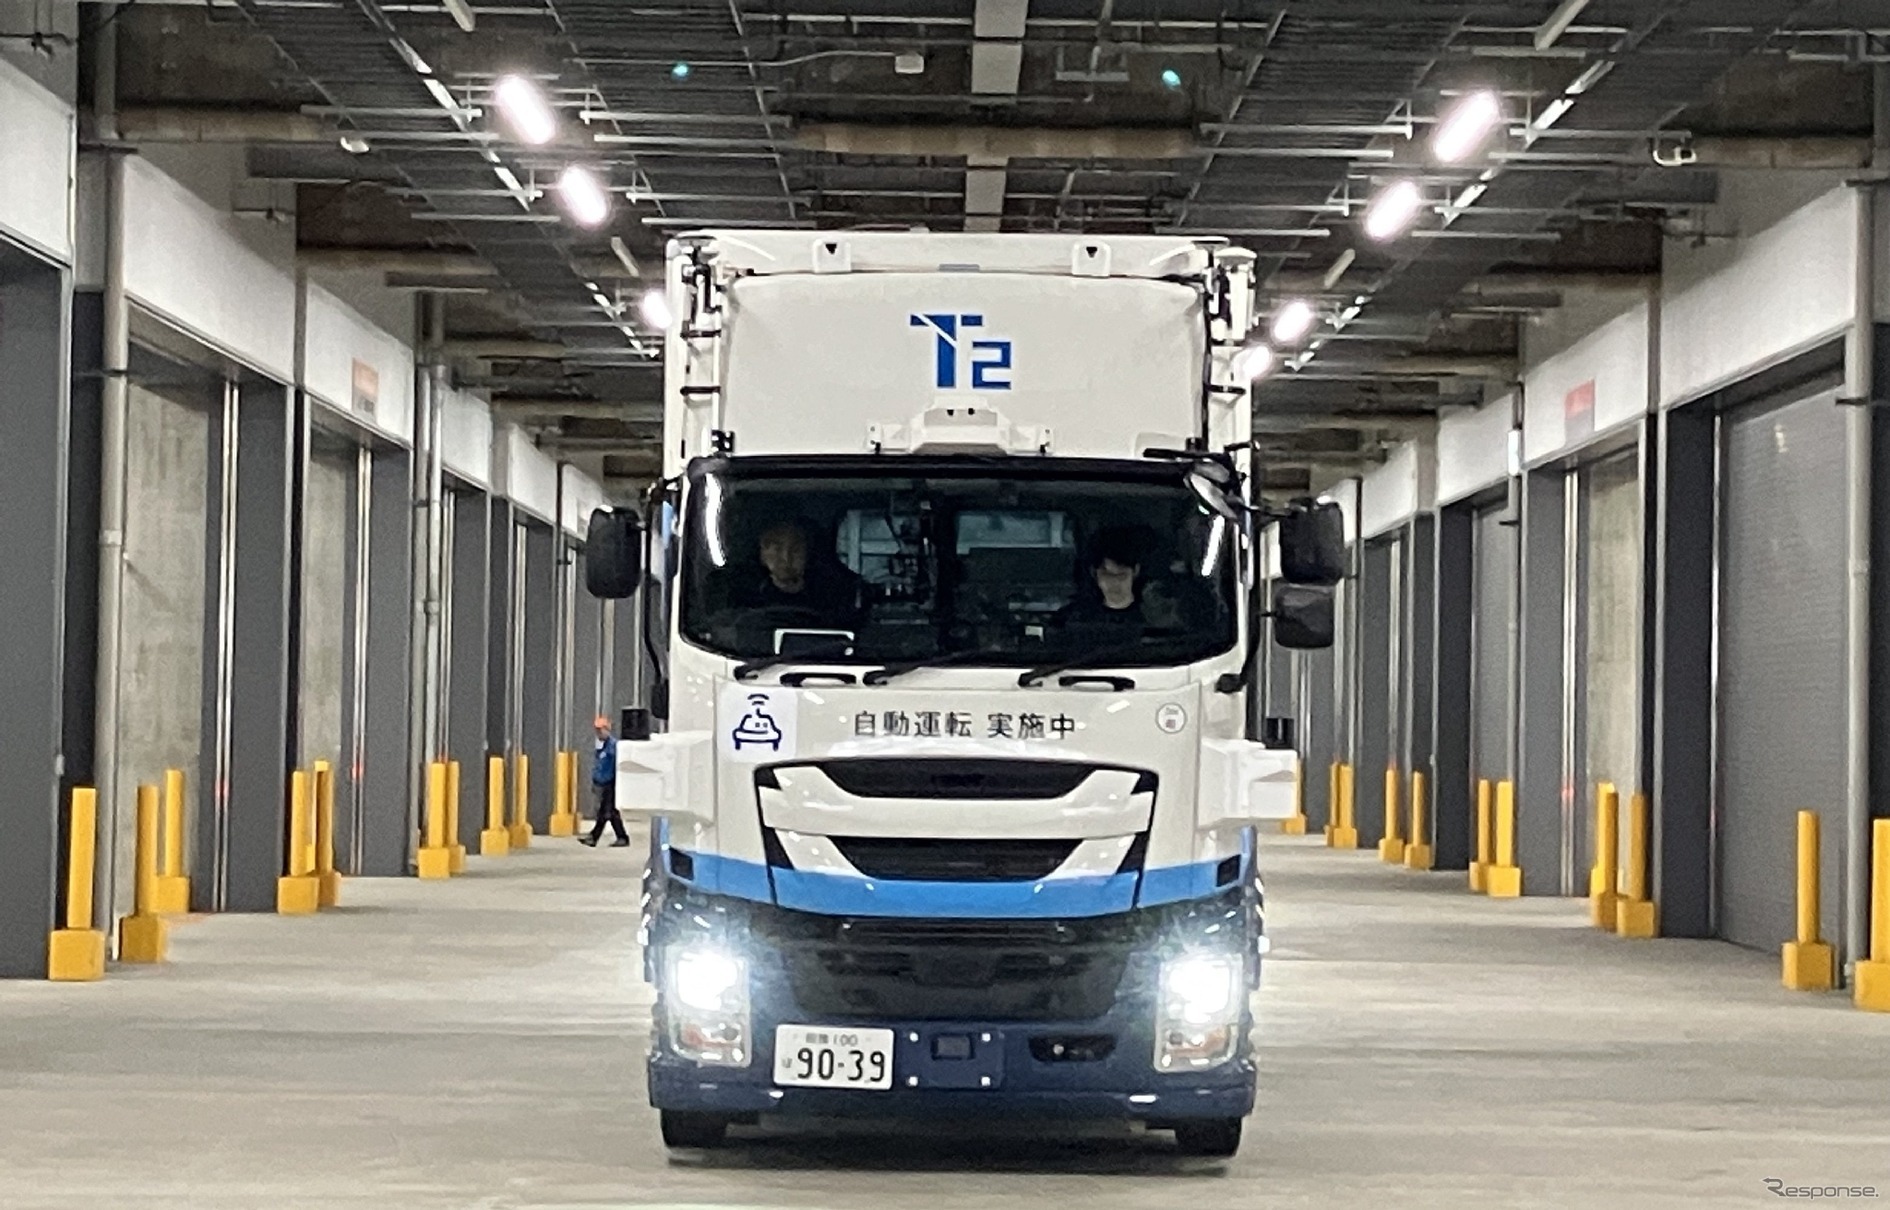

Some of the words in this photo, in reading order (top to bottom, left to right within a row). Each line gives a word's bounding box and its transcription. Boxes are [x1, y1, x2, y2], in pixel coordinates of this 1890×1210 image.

[910, 314, 1012, 389] T2
[854, 710, 973, 738] 自動運転
[987, 712, 1076, 740] 実施中
[797, 1047, 885, 1082] 90-39
